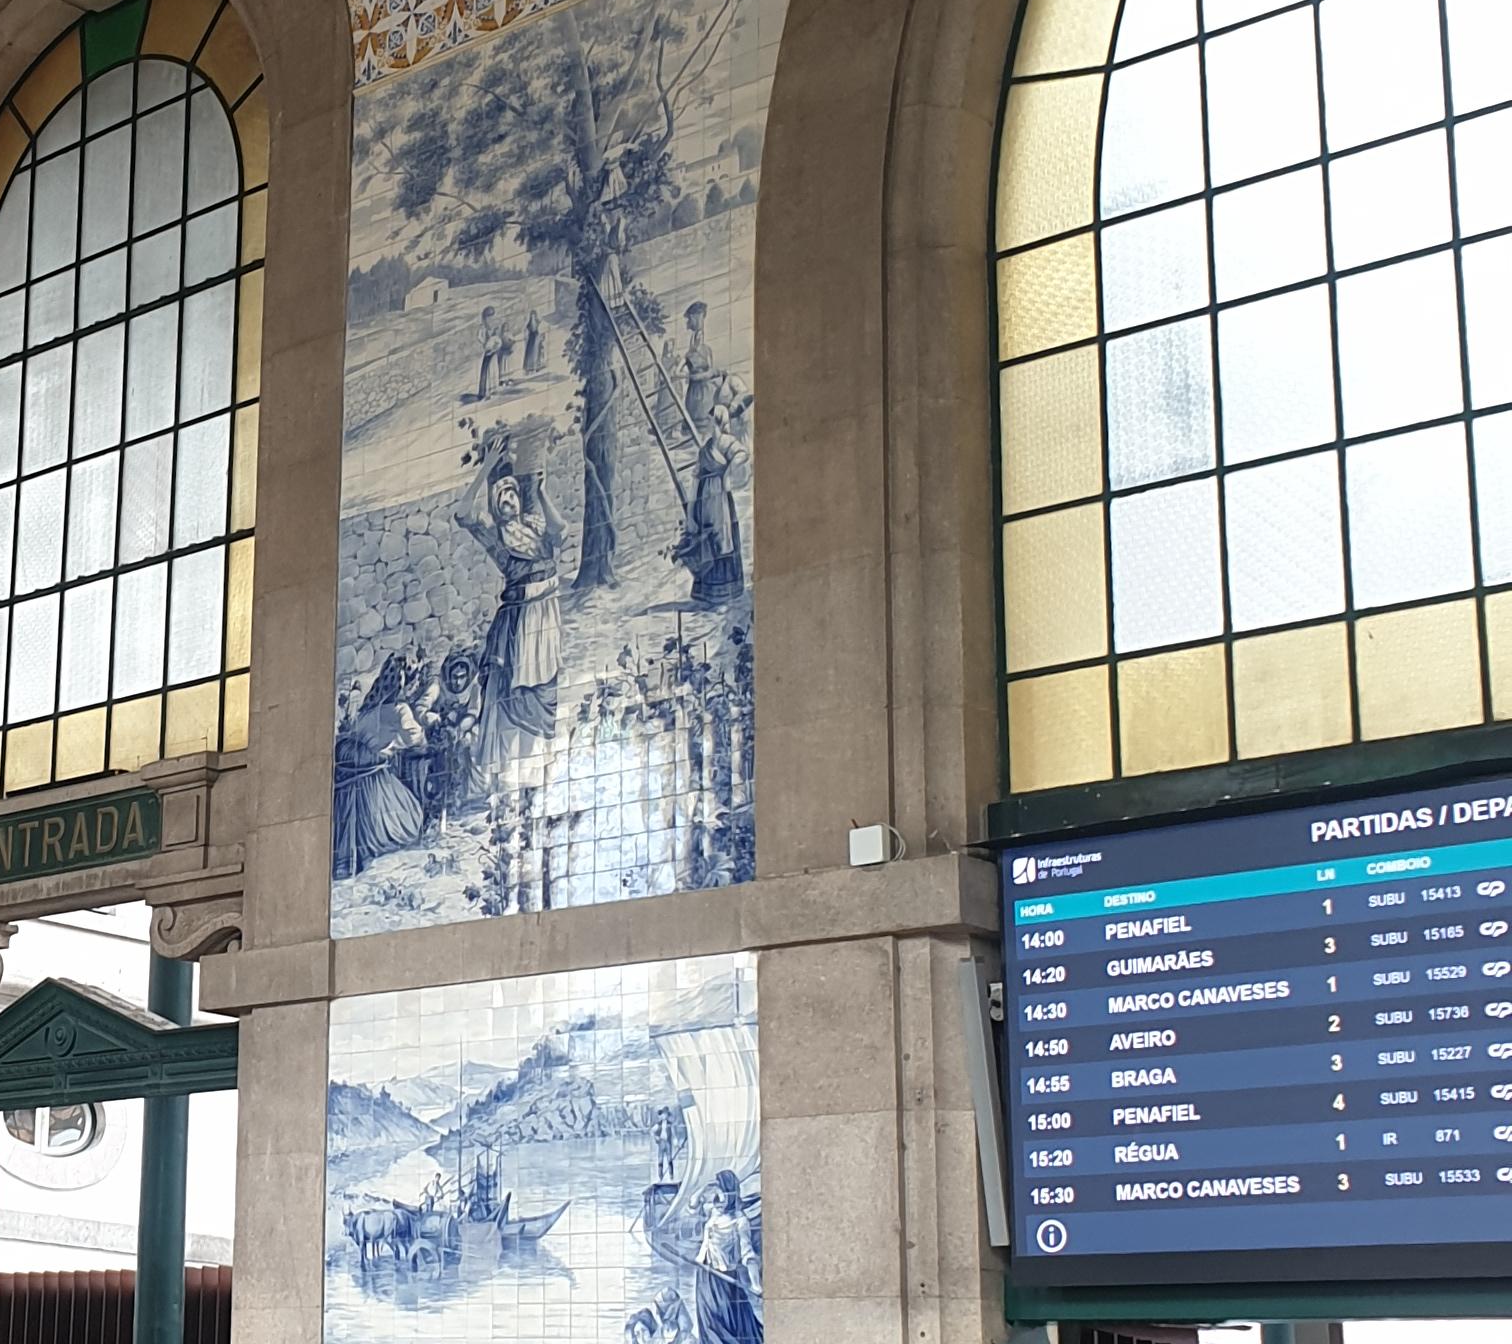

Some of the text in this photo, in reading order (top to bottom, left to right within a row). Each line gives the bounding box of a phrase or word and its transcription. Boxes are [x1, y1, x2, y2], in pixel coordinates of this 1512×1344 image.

[1312, 808, 1433, 842] PARTIDAS
[1439, 805, 1447, 825] /
[1038, 853, 1101, 869] Infraestruturas
[1050, 864, 1082, 877] Portugal
[1021, 904, 1052, 916] HORA
[1105, 892, 1155, 907] DESTINO
[1368, 857, 1430, 874] COMBOIO
[1022, 886, 1461, 949] 14:00 PENAFIEL 1 SUBU 15413
[1023, 966, 1065, 985] 14:20
[1107, 951, 1213, 976] GUIMARÃES
[1325, 938, 1336, 953] 3
[1371, 932, 1407, 946] SUBU
[1025, 966, 1466, 1021] 14:30 MARCO CANAVESES 1 SUBU 15529
[1026, 1039, 1068, 1057] 14:50
[1110, 1030, 1176, 1050] AVEIRO
[1329, 1015, 1340, 1031] 2
[1376, 1011, 1412, 1025] SUBU
[1027, 1046, 1472, 1093] 14:55 BRAGA 3 SUBU 15227
[1028, 1087, 1474, 1130] 15:00 PENAFIEL 4 SUBU 15415
[1030, 1150, 1072, 1167] 15:20
[1115, 1142, 1178, 1163] RÉGUA
[1336, 1134, 1345, 1150] 1
[1383, 1133, 1397, 1145] IR
[1031, 1170, 1480, 1204] 15:30 MARCO CANAVESES 3 SUBU 15533
